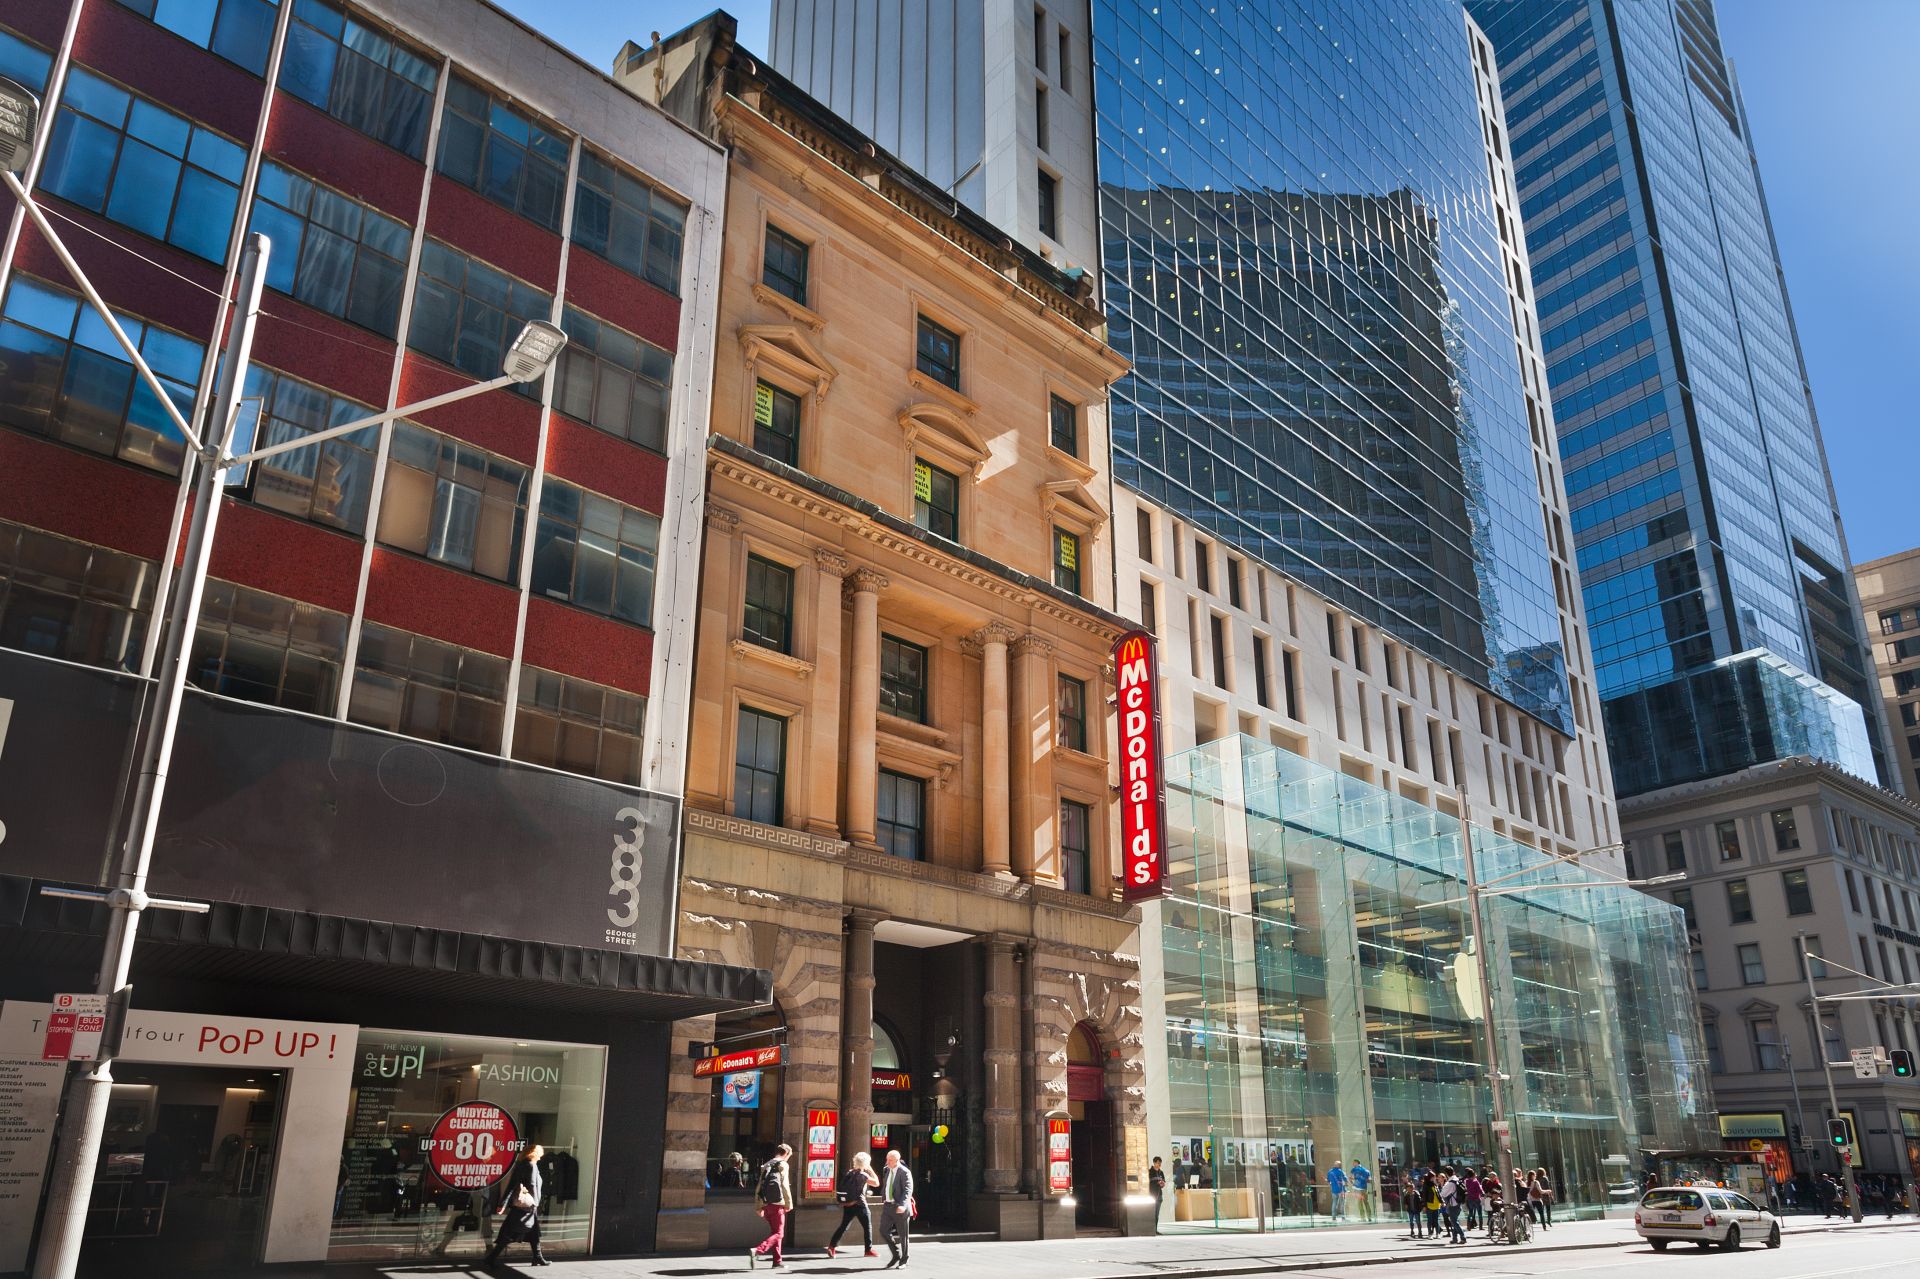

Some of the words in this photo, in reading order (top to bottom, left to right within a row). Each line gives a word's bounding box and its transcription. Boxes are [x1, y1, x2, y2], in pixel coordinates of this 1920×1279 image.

[1120, 658, 1157, 884] McDonald's
[606, 929, 637, 939] GEORGE
[605, 936, 636, 946] STREET
[126, 1026, 185, 1043] lfour
[274, 1031, 320, 1058] UP
[478, 1064, 559, 1083] FASHION
[456, 1107, 500, 1119] MIDYEAR
[450, 1118, 504, 1130] CLEARANCE
[421, 1140, 437, 1150] UP
[440, 1140, 454, 1150] TO
[506, 1140, 526, 1152] OFF
[440, 1164, 464, 1176] NEW
[466, 1164, 502, 1176] WINTER
[454, 1176, 488, 1187] STOCK
